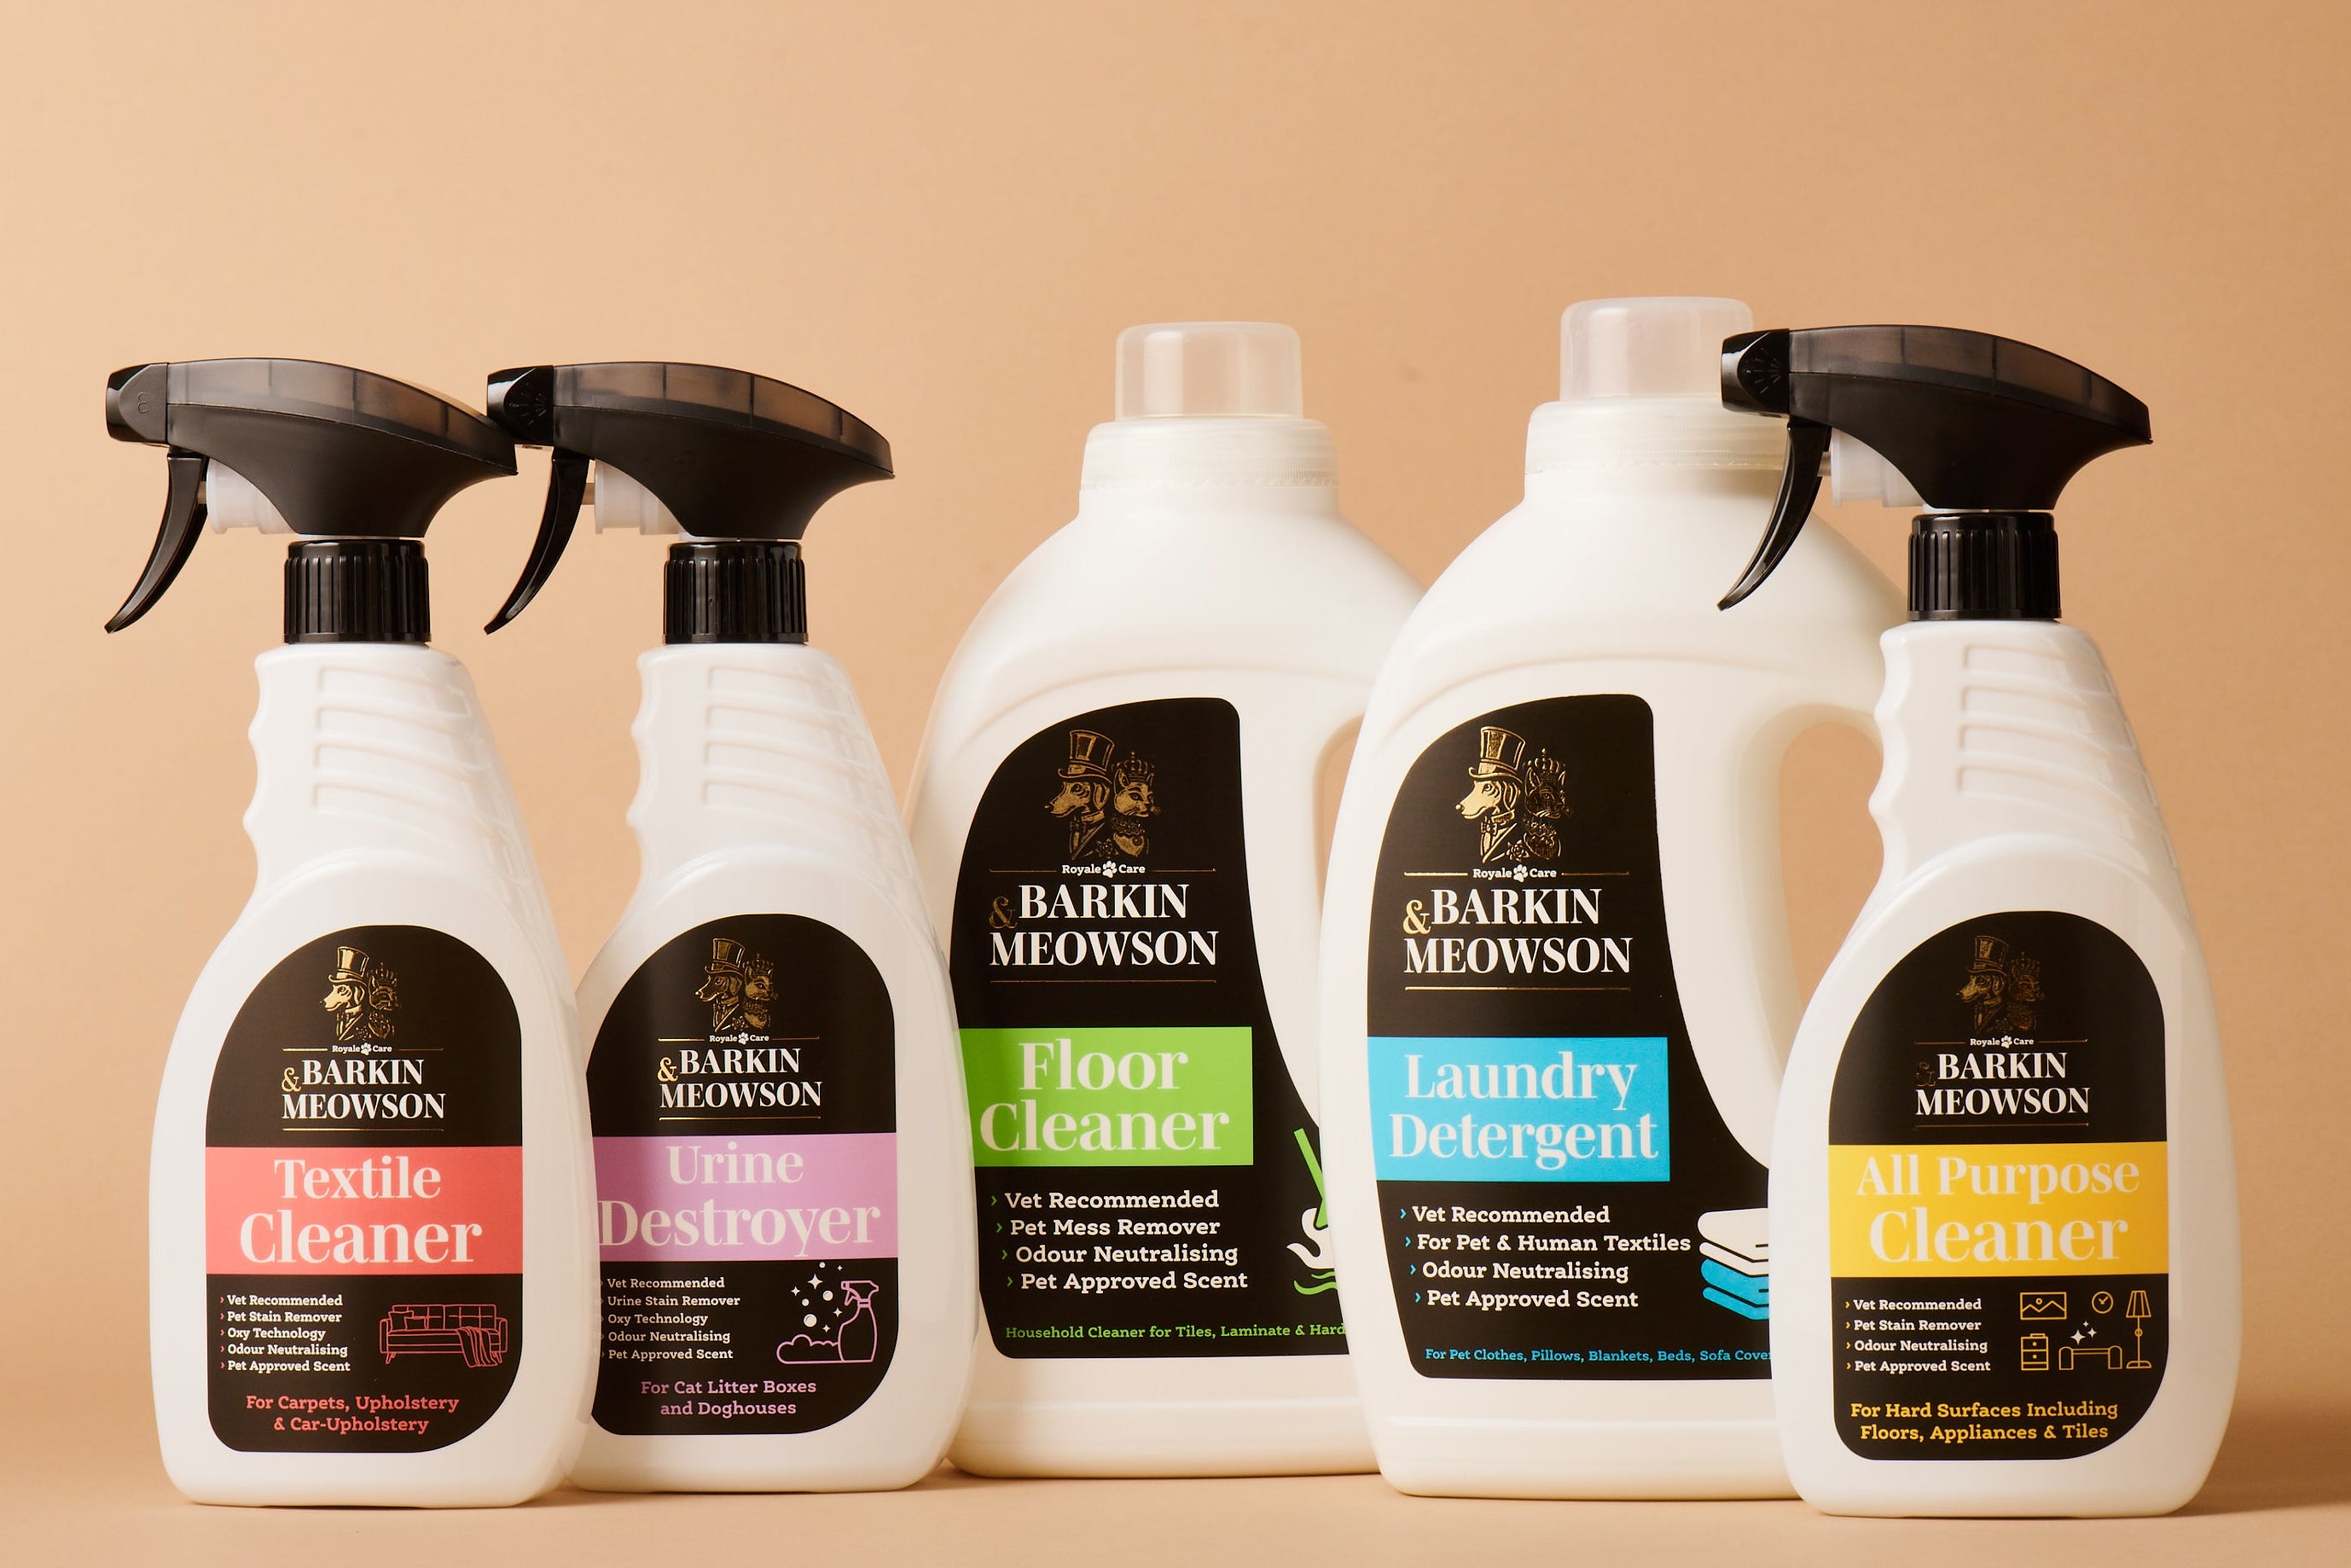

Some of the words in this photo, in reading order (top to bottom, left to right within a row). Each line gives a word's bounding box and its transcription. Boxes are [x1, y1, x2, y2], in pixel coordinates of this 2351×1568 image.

[1062, 863, 1101, 876] Royale
[1118, 863, 1146, 874] Care
[1472, 868, 1512, 880] Royale
[1529, 868, 1557, 878] Care
[989, 895, 1018, 929] &
[1019, 883, 1189, 919] BARKIN
[1402, 899, 1431, 934] &
[1431, 888, 1602, 925] BARKIN
[990, 930, 1219, 967] MEOWSON
[1403, 938, 1633, 973] MEOWSON
[710, 1035, 738, 1043] Royale
[750, 1034, 769, 1042] Care
[1970, 1037, 2000, 1048] Royale
[2013, 1037, 2035, 1046] Care
[332, 1044, 360, 1054] Royale
[373, 1044, 392, 1053] Care
[657, 1057, 678, 1082] &
[679, 1048, 801, 1074] BARKIN
[1019, 1038, 1188, 1090] Floor
[1937, 1052, 2068, 1080] BARKIN
[282, 1067, 302, 1092] &
[302, 1059, 425, 1085] BARKIN
[1404, 1051, 1637, 1112] Laundry
[659, 1081, 822, 1108] MEOWSON
[1915, 1087, 2090, 1116] MEOWSON
[282, 1093, 445, 1119] MEOWSON
[980, 1099, 1229, 1152] Cleaner
[1388, 1112, 1659, 1170] Detergent
[665, 1141, 804, 1184] Urine
[274, 1155, 441, 1199] Textile
[1855, 1154, 1920, 1196] All
[1935, 1156, 2139, 1205] Purpose
[1005, 1193, 1042, 1209] Vet
[1048, 1189, 1219, 1209] Recommended
[1412, 1206, 1446, 1222] Vet
[1451, 1205, 1611, 1223] Recommended
[239, 1209, 483, 1263] Cleaner
[598, 1198, 880, 1257] Destroyer
[1010, 1220, 1047, 1235] Pet
[1053, 1220, 1110, 1235] Mess
[1117, 1219, 1221, 1235] Remover
[1870, 1207, 2129, 1263] Cleaner
[1417, 1234, 1451, 1251] For
[1456, 1234, 1490, 1251] Pet
[1497, 1235, 1511, 1251] &
[1518, 1235, 1599, 1251] Human
[1604, 1233, 1691, 1251] Textiles
[1016, 1245, 1087, 1263] Odour
[1094, 1243, 1238, 1266] Neutralising
[1422, 1260, 1487, 1279] Odour
[1493, 1261, 1628, 1284] Neutralising
[607, 1278, 627, 1288] Vet
[630, 1277, 725, 1288] Recommended
[1021, 1274, 1057, 1290] Pet
[1064, 1271, 1176, 1293] Approved
[1183, 1272, 1248, 1289] Scent
[227, 1295, 247, 1306] Vet
[249, 1294, 343, 1306] Recommended
[607, 1296, 641, 1306] Urine
[645, 1295, 679, 1306] Stain
[682, 1296, 740, 1306] Remover
[1427, 1290, 1460, 1307] Pet
[1466, 1290, 1570, 1310] Approved
[1576, 1291, 1639, 1308] Scent
[1854, 1299, 1875, 1310] Vet
[1878, 1298, 1982, 1310] Recommended
[227, 1311, 247, 1322] Pet
[248, 1310, 282, 1322] Stain
[284, 1312, 342, 1322] Remover
[608, 1314, 631, 1326] Oxy
[634, 1313, 708, 1326] Technology
[1854, 1320, 1876, 1331] Pet
[1878, 1319, 1915, 1331] Stain
[1919, 1319, 1982, 1331] Remover
[227, 1327, 250, 1341] Oxy
[253, 1327, 326, 1341] Technology
[608, 1331, 647, 1342] Odour
[649, 1330, 730, 1344] Neutralising
[1006, 1326, 1084, 1339] Household
[1088, 1326, 1145, 1339] Cleaner
[1150, 1326, 1171, 1338] for
[1176, 1325, 1216, 1339] Tiles,
[1220, 1324, 1291, 1338] Laminate
[1295, 1325, 1305, 1336] &
[1309, 1323, 1346, 1336] Hard
[228, 1343, 264, 1355] Odour
[268, 1344, 348, 1357] Neutralising
[608, 1349, 628, 1359] Pet
[631, 1348, 693, 1362] Approved
[696, 1349, 733, 1359] Scent
[1855, 1339, 1896, 1352] Odour
[1900, 1339, 1988, 1354] Neutralising
[1425, 1349, 1447, 1360] For
[1449, 1349, 1471, 1360] Pet
[1474, 1349, 1528, 1363] Clothes,
[1530, 1349, 1584, 1363] Pillows,
[1588, 1350, 1653, 1363] Blankets,
[1657, 1350, 1695, 1364] Beds,
[1699, 1349, 1731, 1362] Sofa
[228, 1361, 247, 1371] Pet
[249, 1360, 311, 1373] Approved
[313, 1361, 351, 1372] Scent
[1855, 1360, 1876, 1372] Pet
[1879, 1359, 1948, 1374] Approved
[1951, 1359, 1991, 1372] Scent
[641, 1381, 670, 1394] For
[674, 1381, 702, 1394] Cat
[707, 1379, 758, 1394] Litter
[763, 1380, 816, 1393] Boxes
[247, 1396, 273, 1409] For
[278, 1396, 350, 1413] Carpets,
[355, 1395, 459, 1413] Upholstery
[660, 1401, 693, 1415] and
[698, 1401, 797, 1419] Doghouses
[1850, 1403, 1881, 1417] For
[1885, 1402, 1932, 1418] Hard
[1937, 1402, 2021, 1418] Surfaces
[2027, 1401, 2118, 1420] Including
[274, 1417, 285, 1432] &
[290, 1416, 429, 1434] Car-Upholstery
[1860, 1424, 1924, 1443] Floors,
[1930, 1424, 2039, 1443] Appliances
[2062, 1423, 2109, 1439] Tiles
